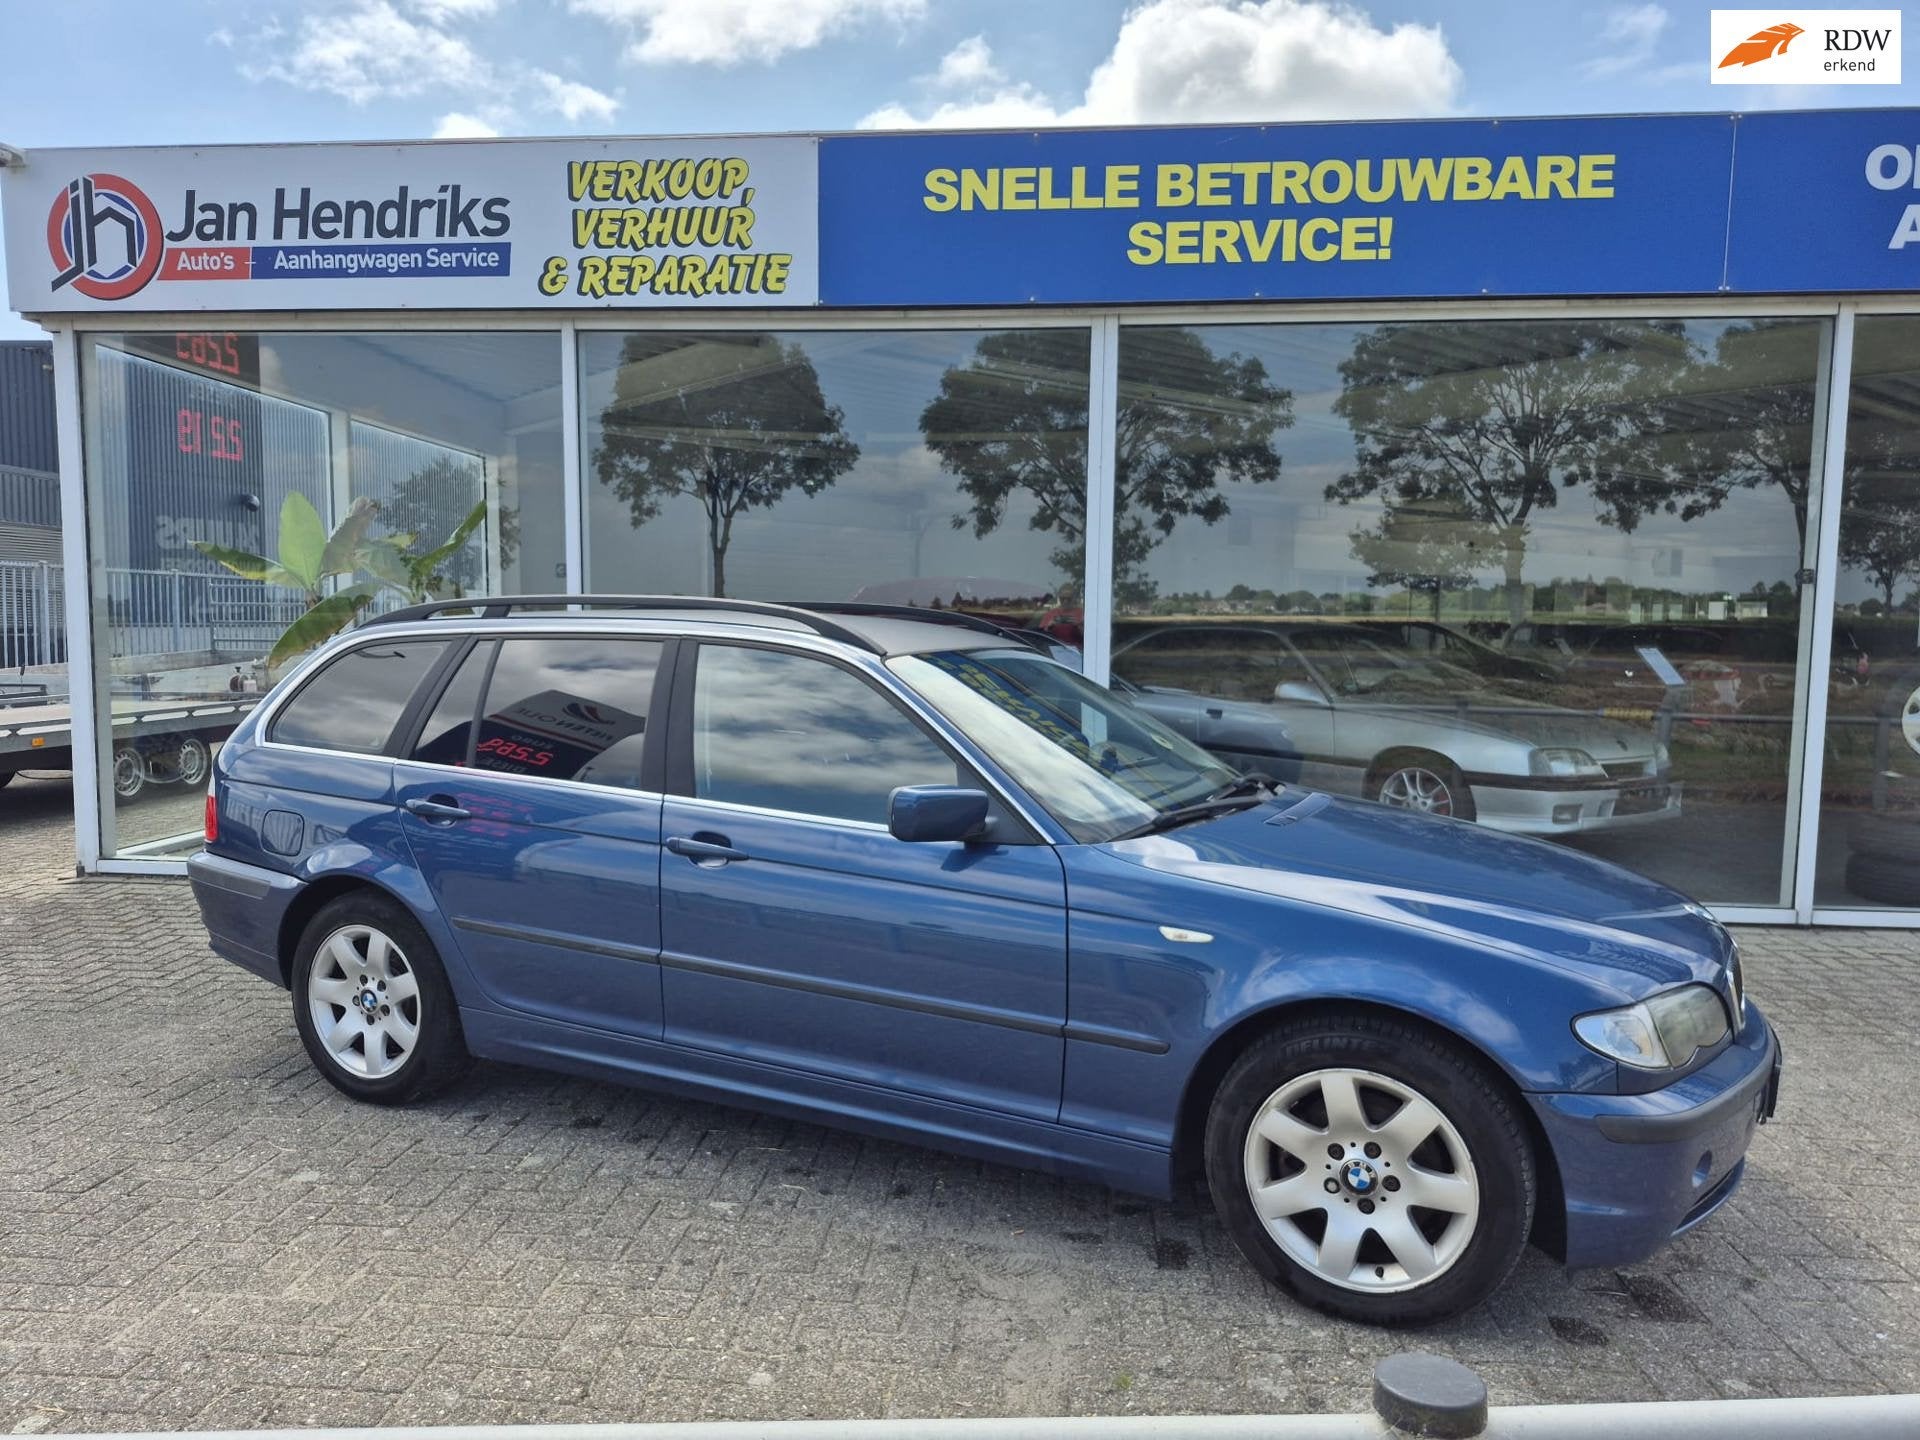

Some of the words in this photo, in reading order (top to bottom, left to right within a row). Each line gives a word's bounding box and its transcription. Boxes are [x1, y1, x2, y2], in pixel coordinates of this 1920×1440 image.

[567, 157, 755, 208] VERKOOP,
[923, 164, 1140, 212] SNELLE
[1156, 154, 1616, 207] BETROUWBARE
[1864, 143, 1920, 191] O
[165, 189, 257, 242] Jan
[572, 205, 755, 251] VERHUUR
[176, 250, 236, 272] Auto's
[273, 250, 423, 274] Aanhangwagen
[426, 247, 499, 268] Service
[1126, 216, 1393, 266] SERVICE!
[538, 255, 569, 296] &
[577, 253, 793, 300] REPARATIE
